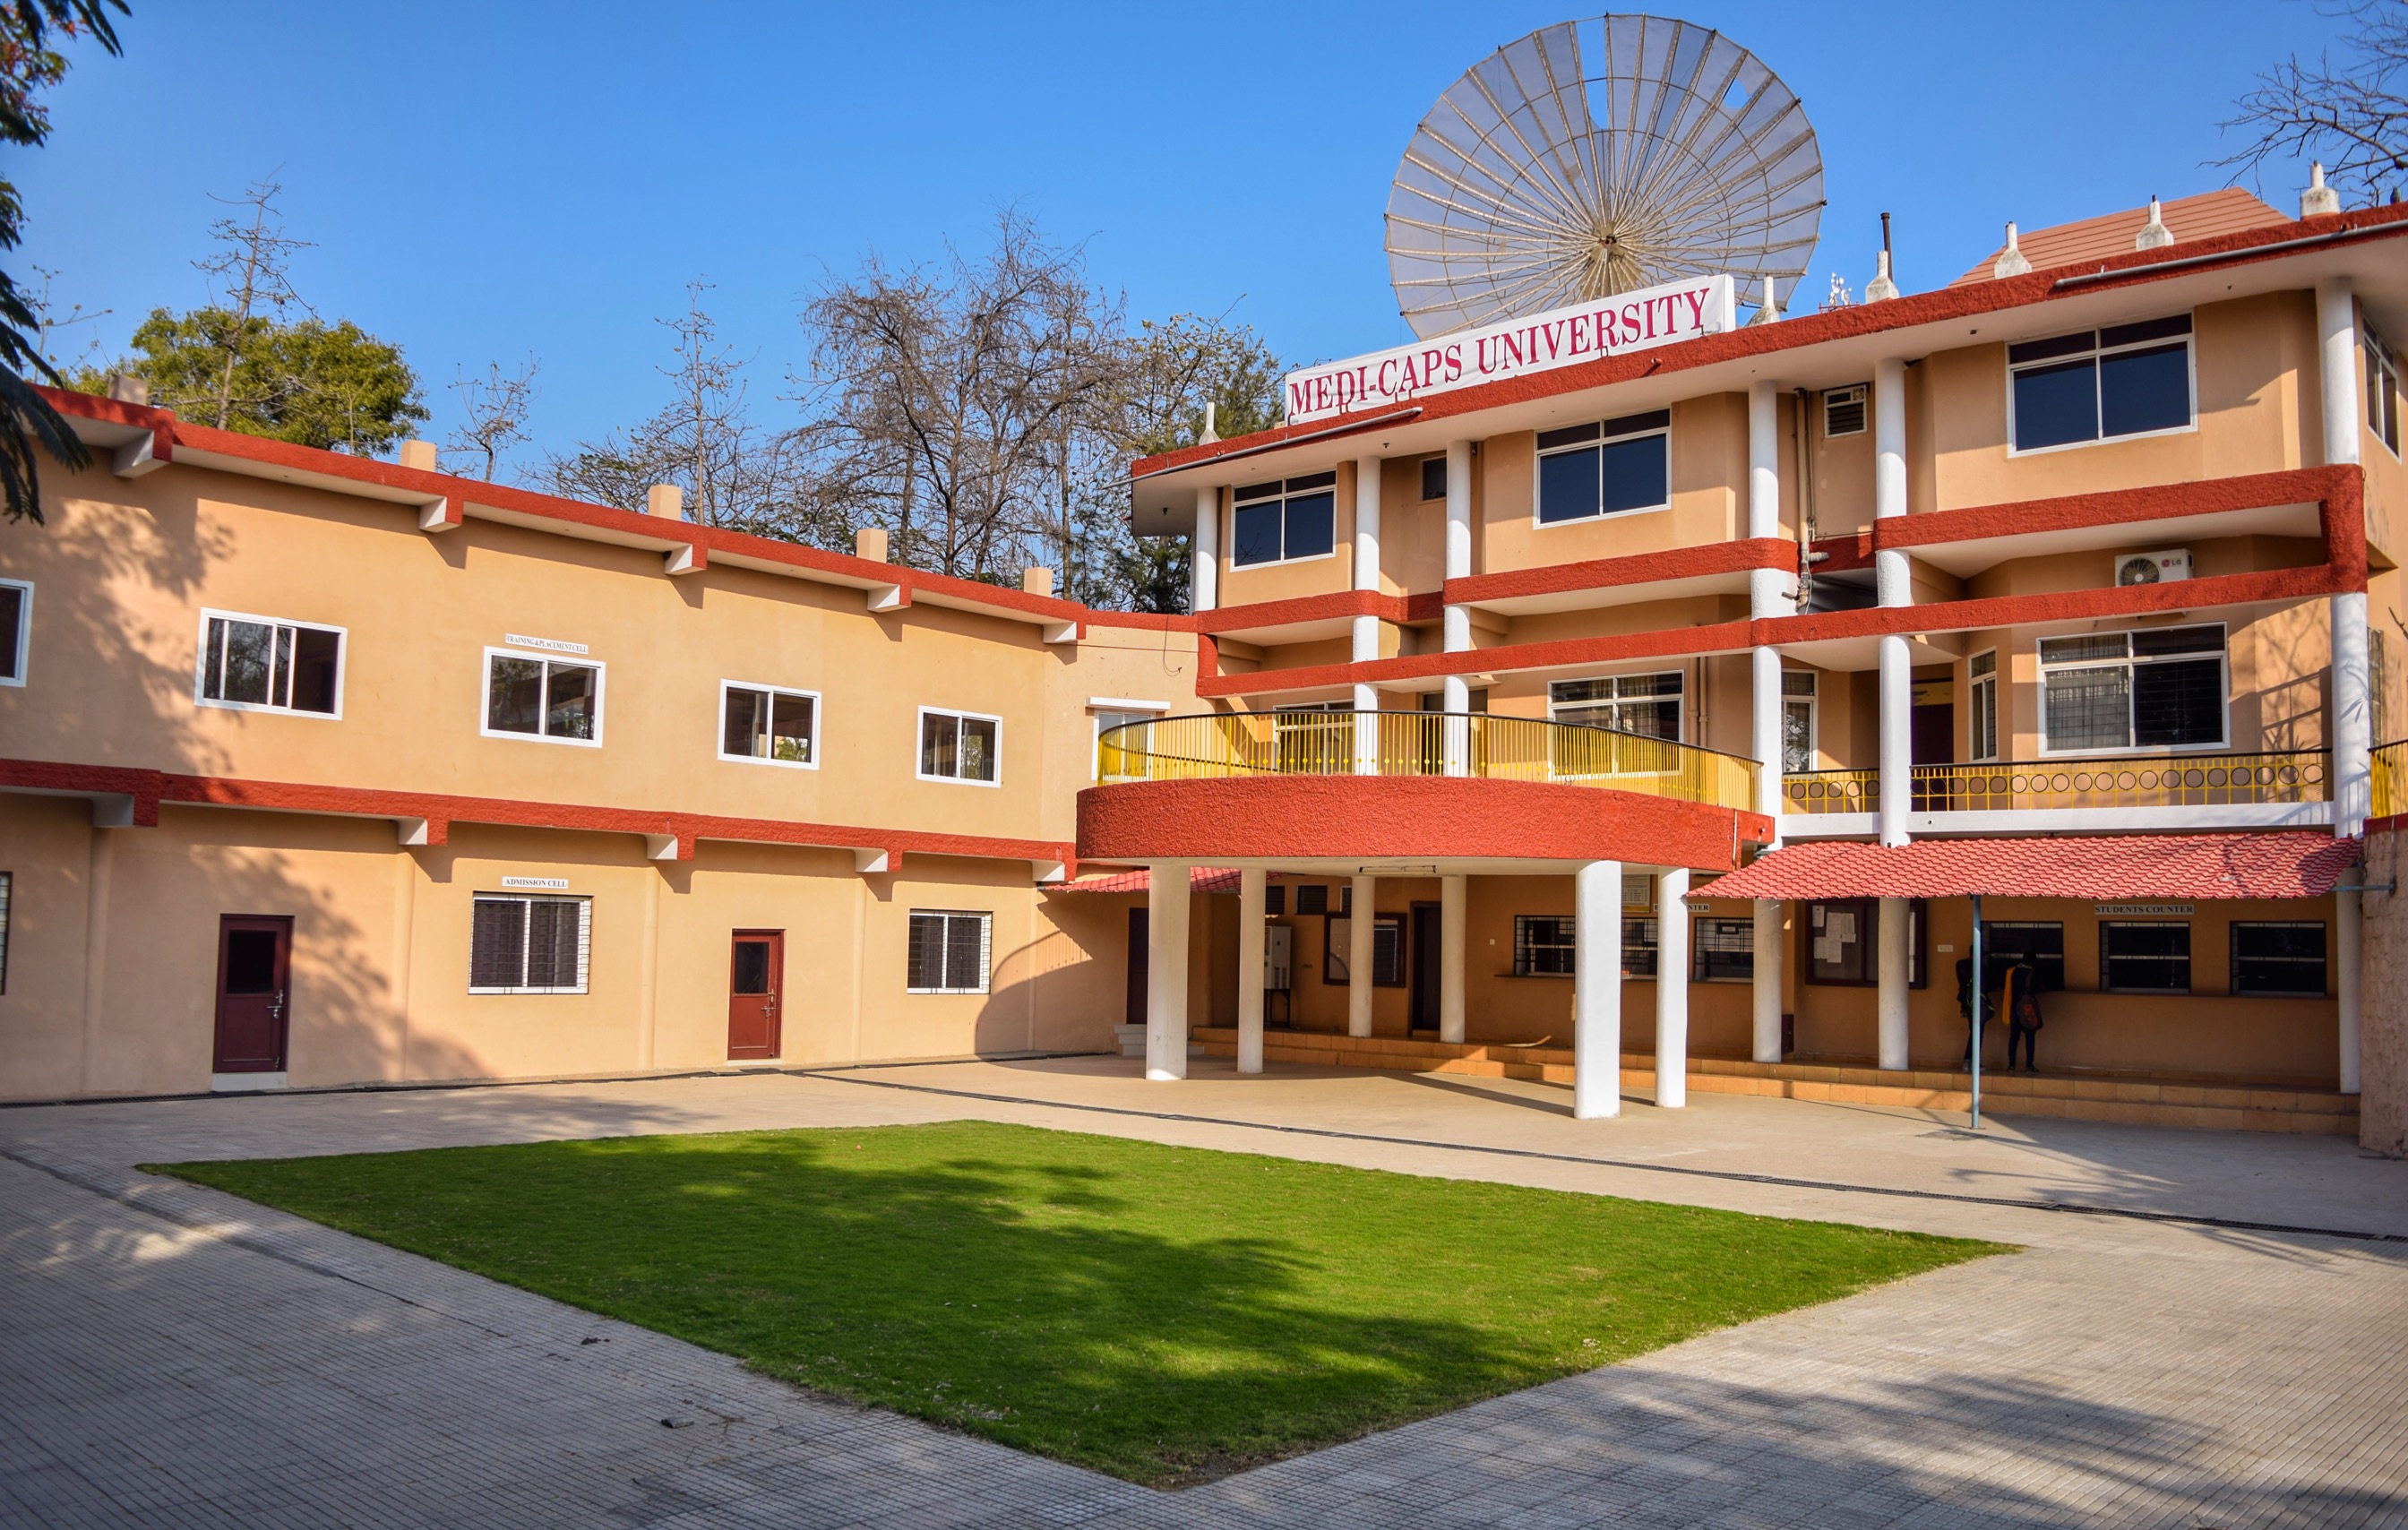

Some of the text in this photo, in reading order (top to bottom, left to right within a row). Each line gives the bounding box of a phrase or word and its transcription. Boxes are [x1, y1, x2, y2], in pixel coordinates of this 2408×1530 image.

[1289, 287, 1711, 417] MEDI-CAPS UNIVERSITY
[507, 635, 535, 645] TRAINING
[572, 645, 587, 653] CELL
[2094, 905, 2193, 914] STUDENTS COUNTER
